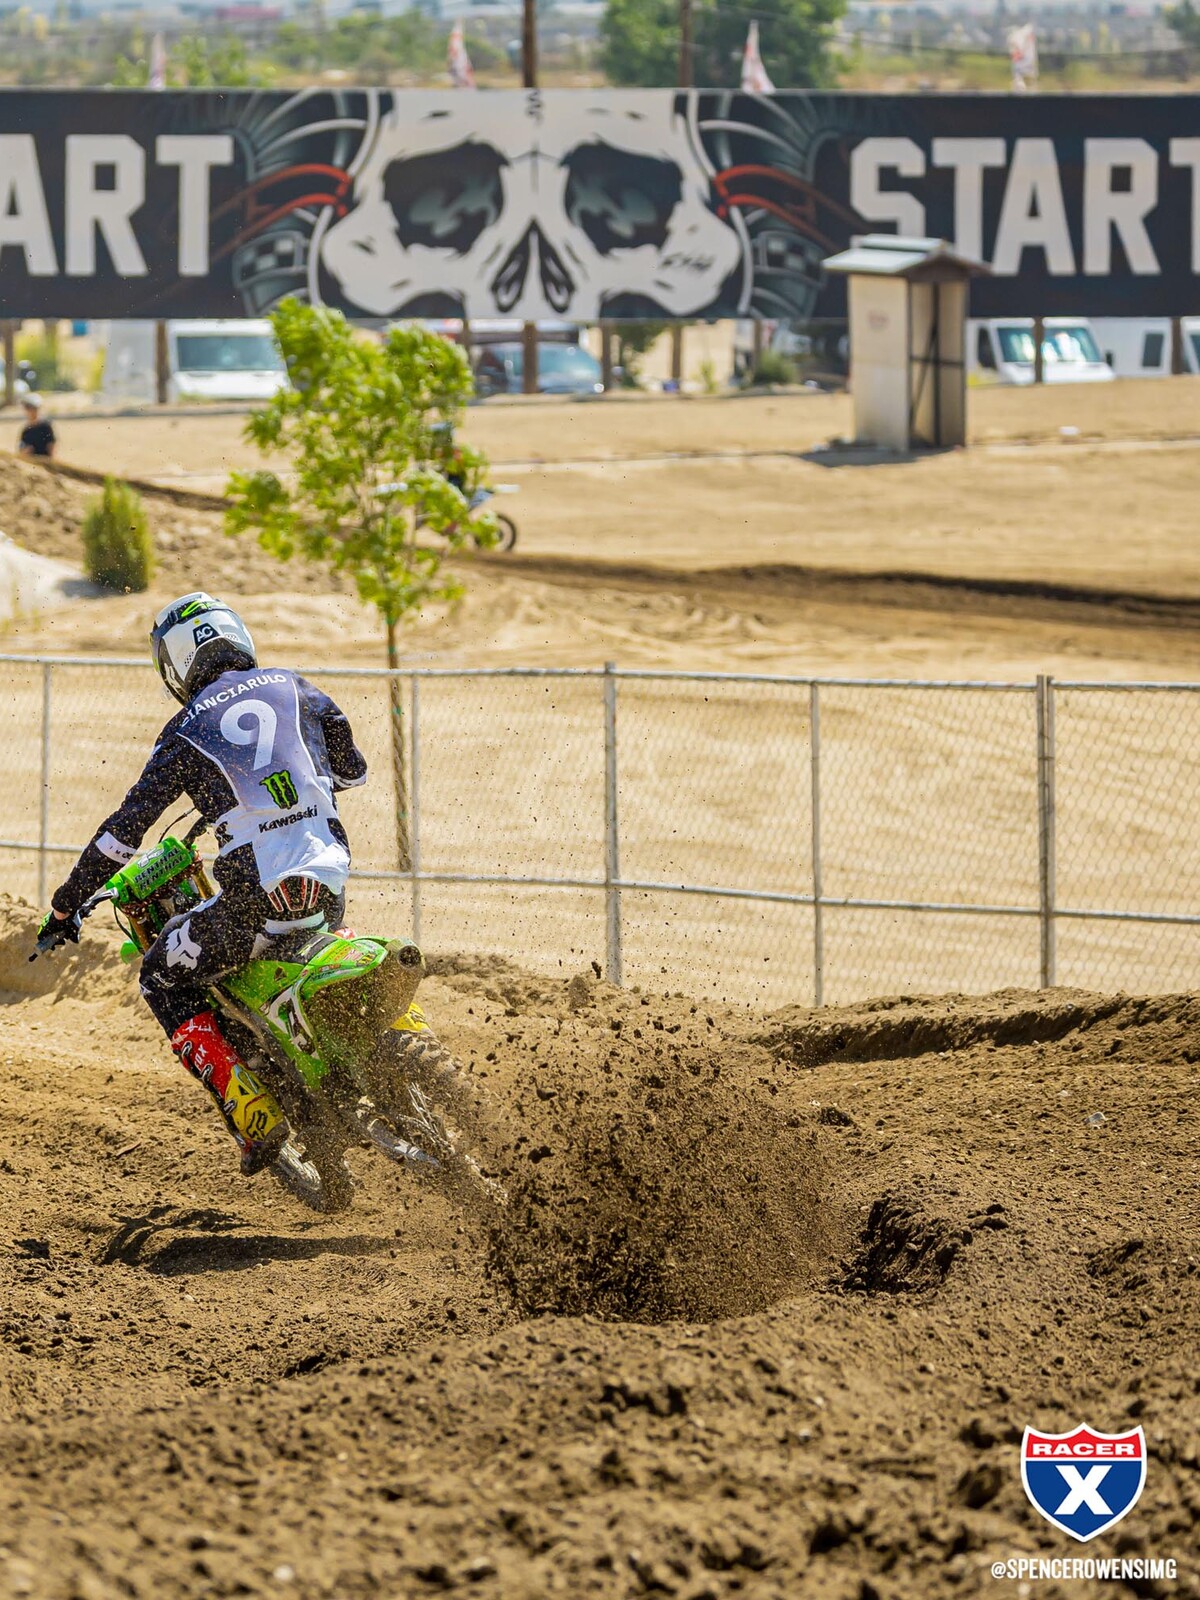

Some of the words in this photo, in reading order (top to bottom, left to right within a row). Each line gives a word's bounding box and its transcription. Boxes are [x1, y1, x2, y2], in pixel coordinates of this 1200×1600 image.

[195, 626, 214, 643] AC
[220, 699, 277, 771] 9
[134, 847, 180, 884] RENTHAL
